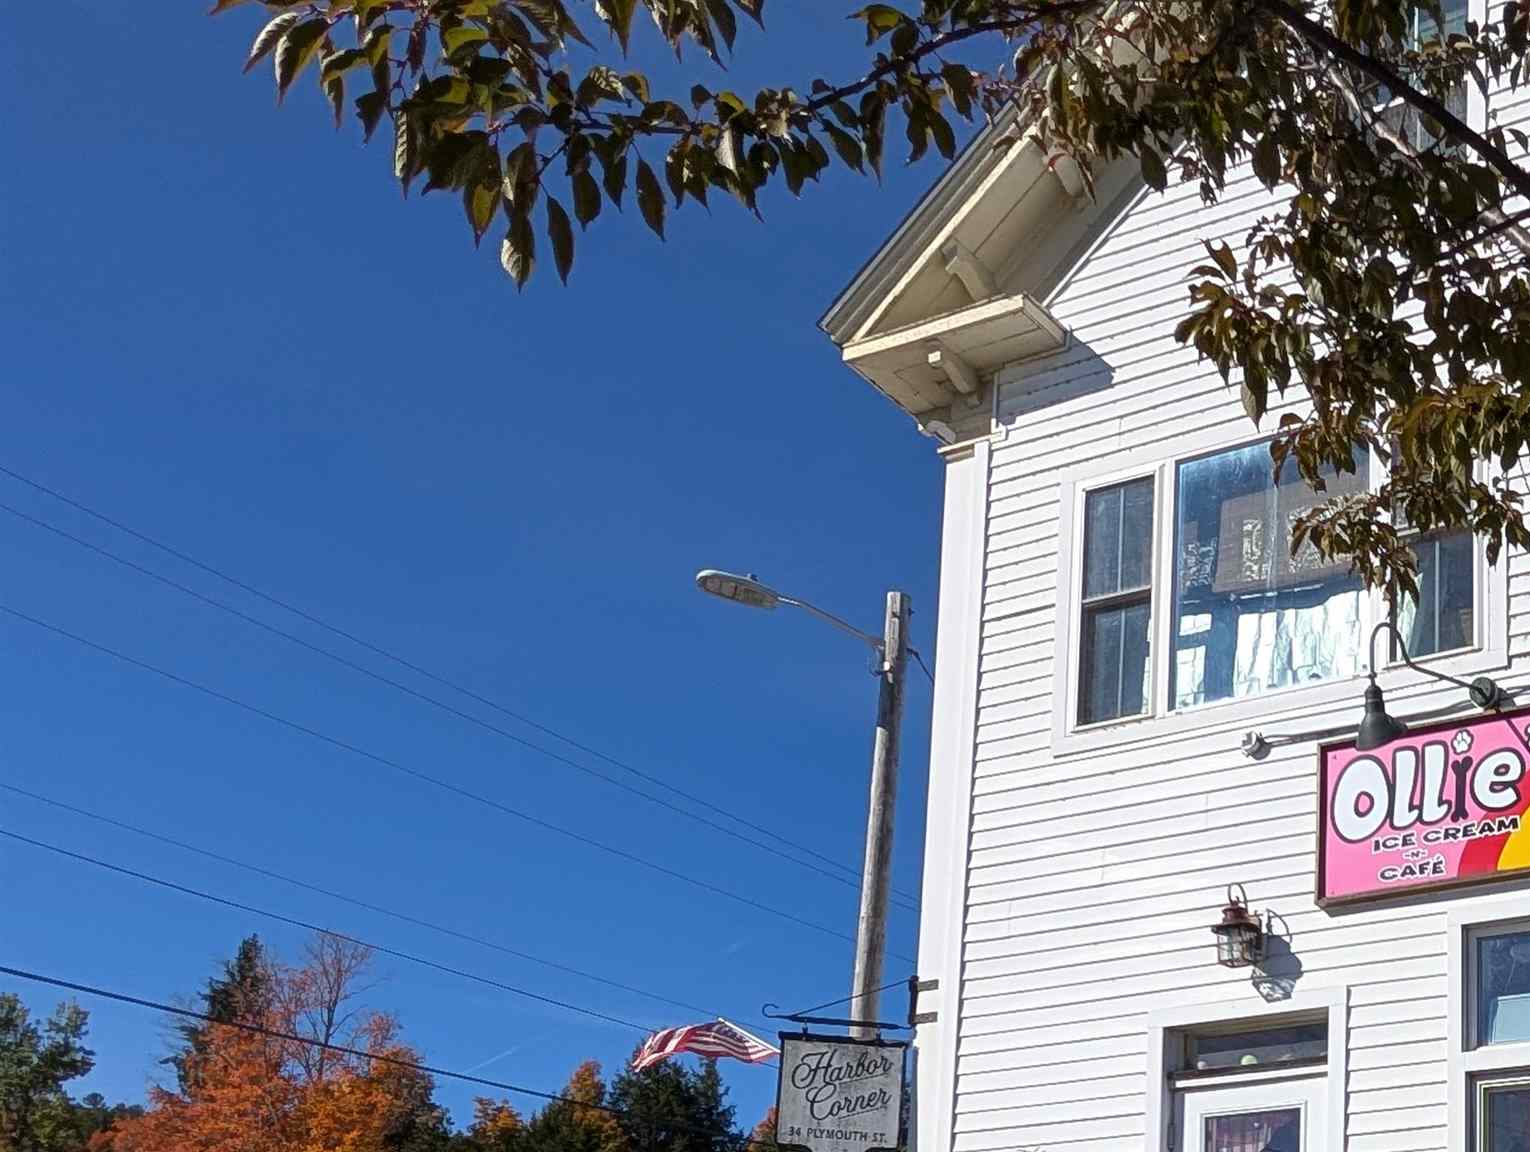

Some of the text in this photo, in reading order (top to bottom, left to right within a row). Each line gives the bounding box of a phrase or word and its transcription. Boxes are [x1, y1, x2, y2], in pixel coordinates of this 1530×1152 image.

[1372, 815, 1520, 852] ICE CREAM
[1378, 857, 1446, 881] CAFÉ
[791, 1049, 894, 1089] Harbor
[805, 1083, 893, 1122] Corner
[807, 1127, 868, 1142] PLYMOUTH
